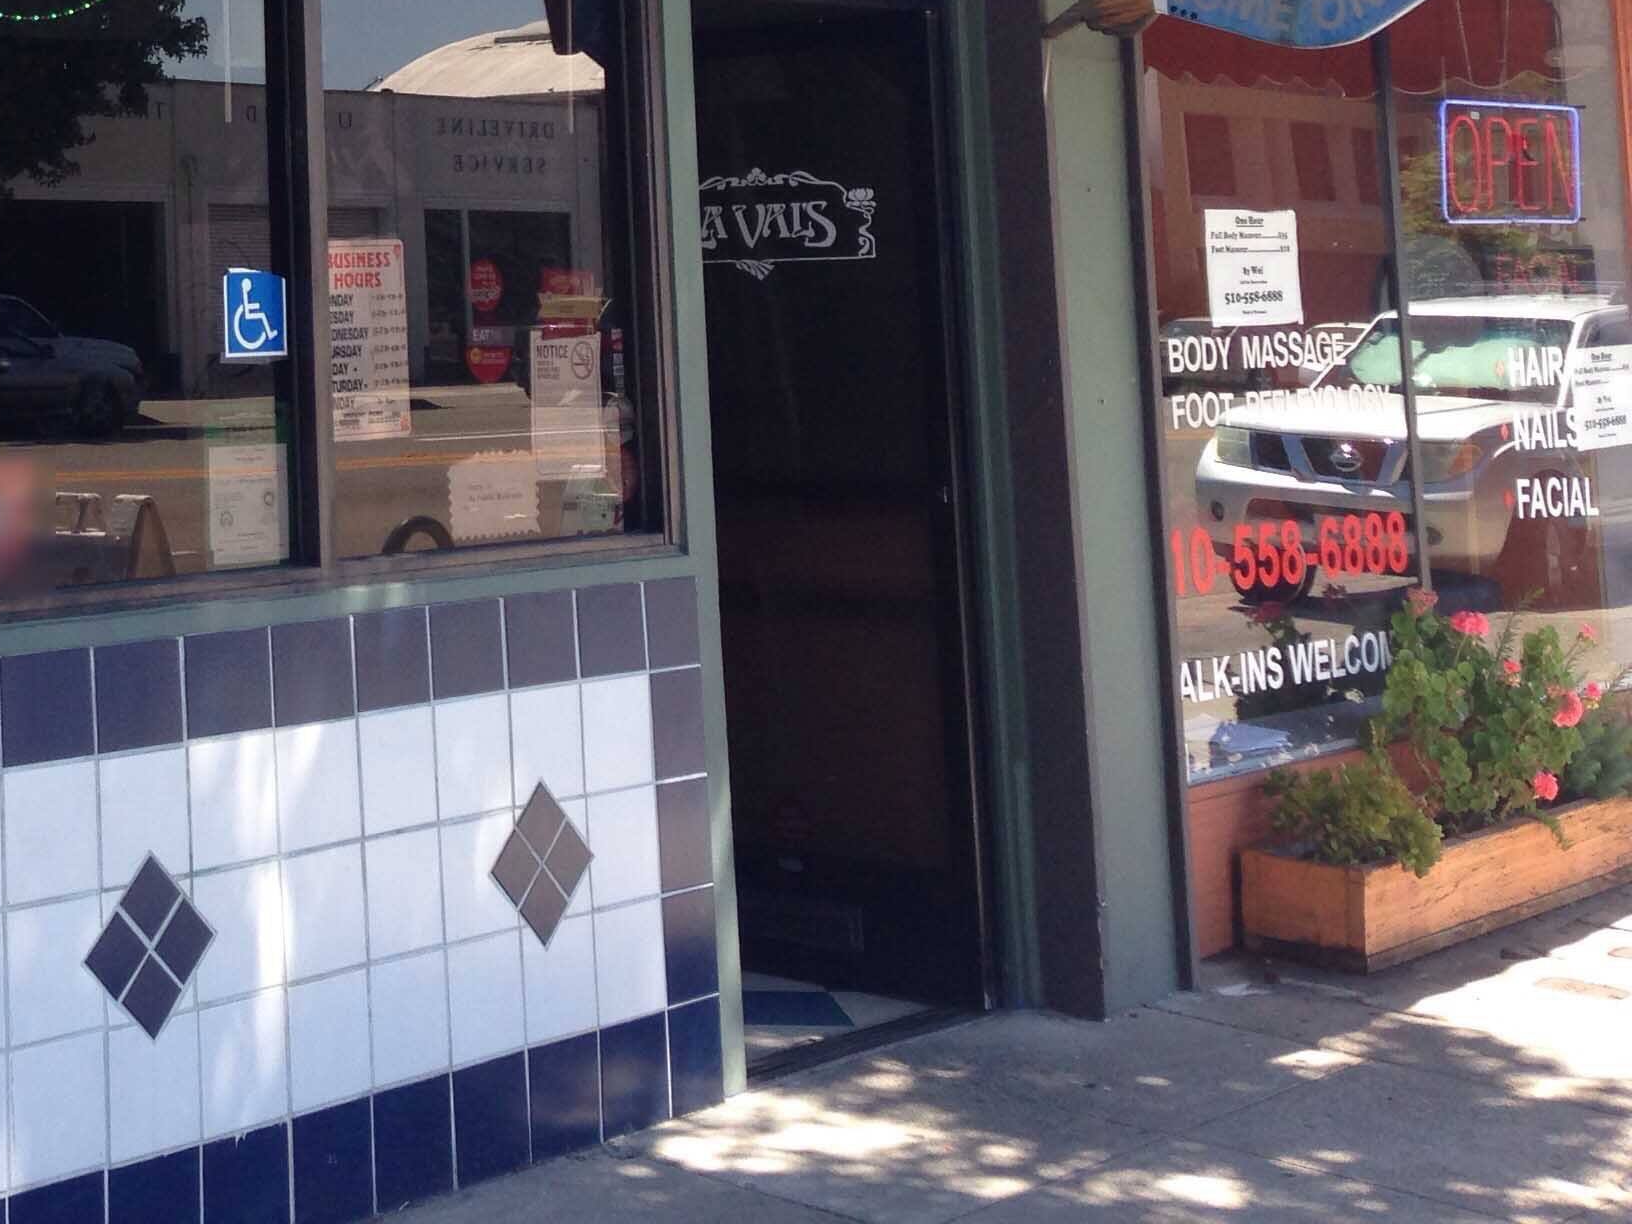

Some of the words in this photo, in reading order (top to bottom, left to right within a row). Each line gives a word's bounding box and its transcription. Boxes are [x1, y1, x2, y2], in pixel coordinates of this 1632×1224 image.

[1447, 114, 1576, 213] OPEN
[334, 272, 383, 290] HOURS
[536, 344, 569, 360] NOTICE
[1168, 336, 1229, 373] BODY
[1241, 331, 1346, 370] MASSAGE
[1508, 345, 1566, 387] HAIR
[1171, 391, 1234, 430] FOOT
[1513, 406, 1579, 452] NAILS
[1516, 476, 1599, 520] FACIAL
